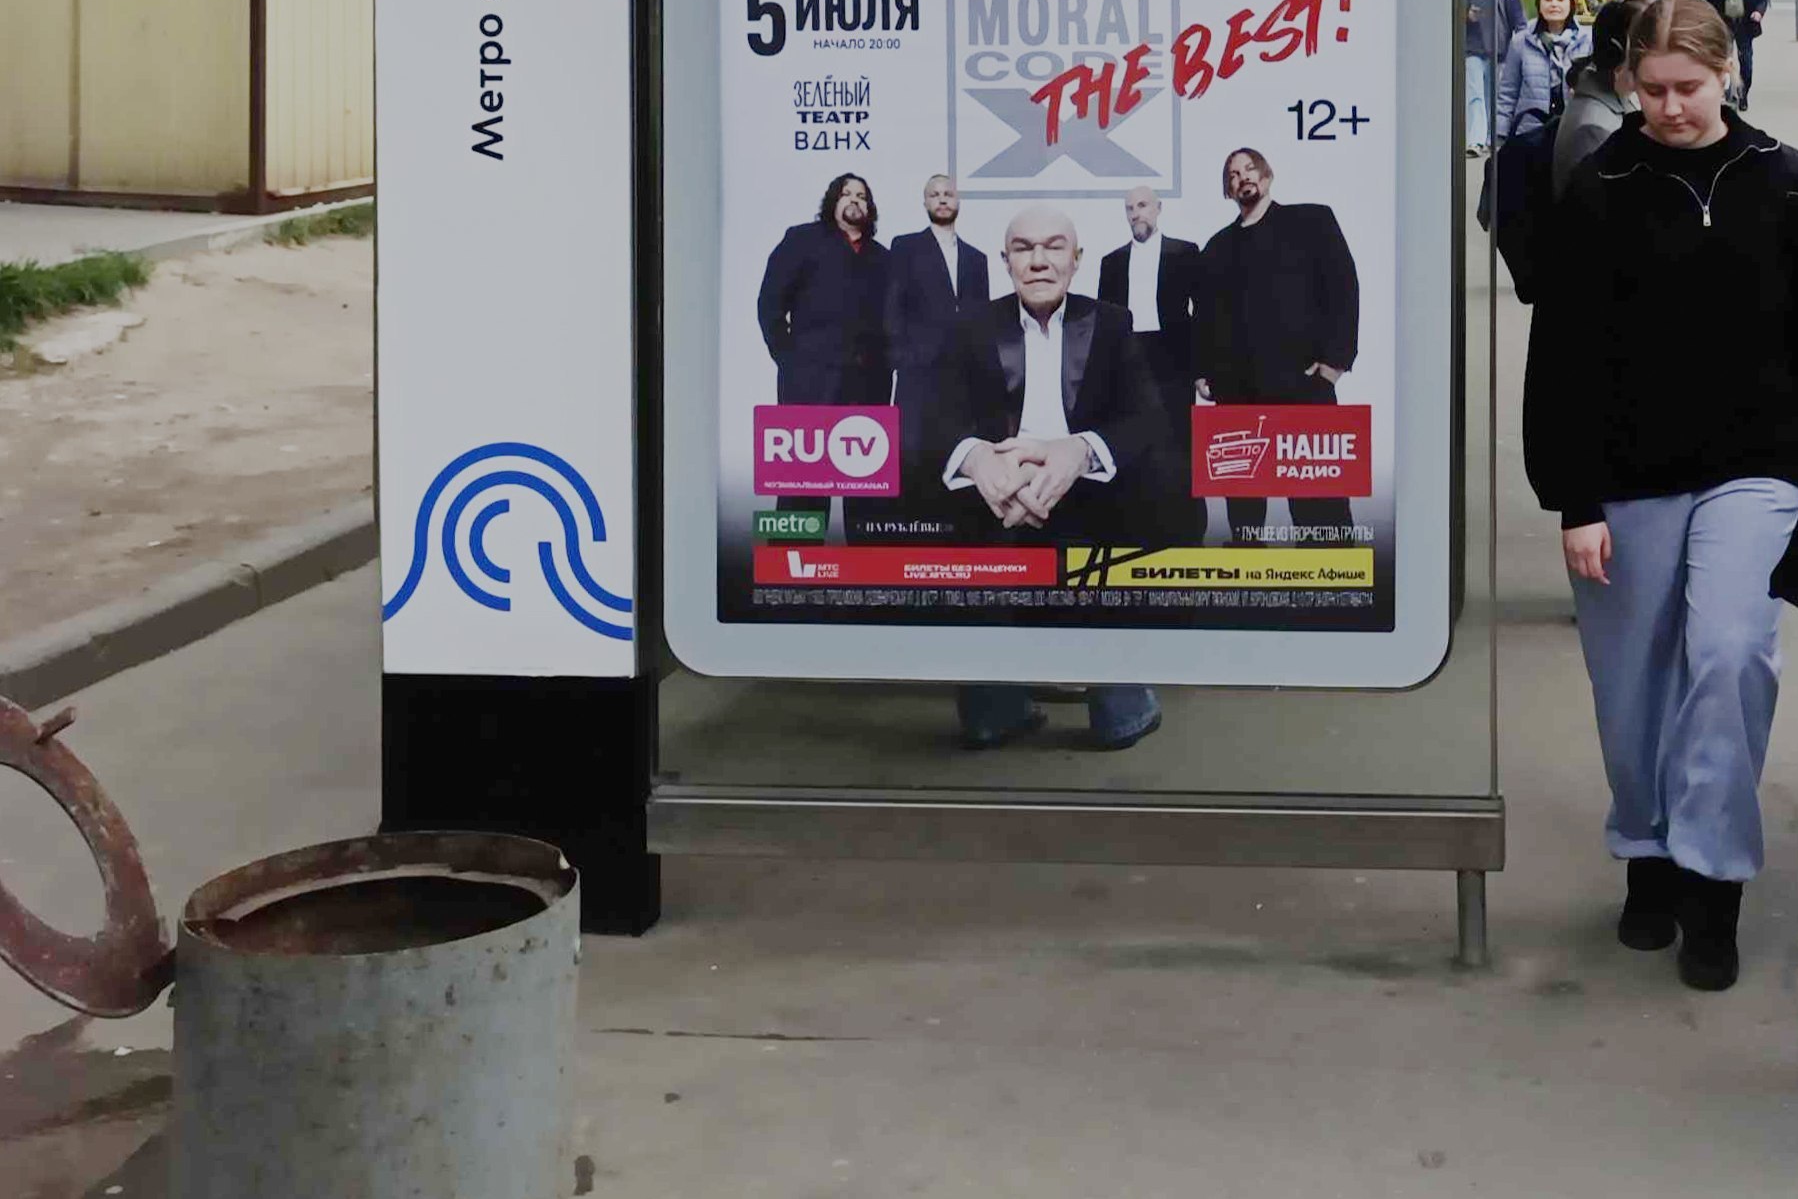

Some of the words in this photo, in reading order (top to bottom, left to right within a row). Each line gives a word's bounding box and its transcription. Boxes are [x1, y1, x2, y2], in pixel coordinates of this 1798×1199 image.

[813, 39, 865, 49] НАЧАЛО
[869, 38, 901, 49] 20:00
[471, 13, 511, 160] Метро
[793, 75, 871, 108] ЗЕЛЁНЫЙ
[1030, 44, 1152, 146] THE
[796, 111, 870, 123] ТЕАТР
[1288, 99, 1370, 140] 12+
[794, 131, 871, 150] ВДНХ
[763, 428, 824, 463] RU
[840, 437, 876, 456] TV
[1276, 434, 1357, 460] НАШЕ
[1276, 465, 1341, 479] РАДИО
[758, 514, 820, 533] metro
[1131, 567, 1240, 579] БИЛЕТЫ
[1245, 570, 1261, 579] на
[1265, 569, 1315, 581] Яндекс
[1317, 568, 1365, 581] Афише
